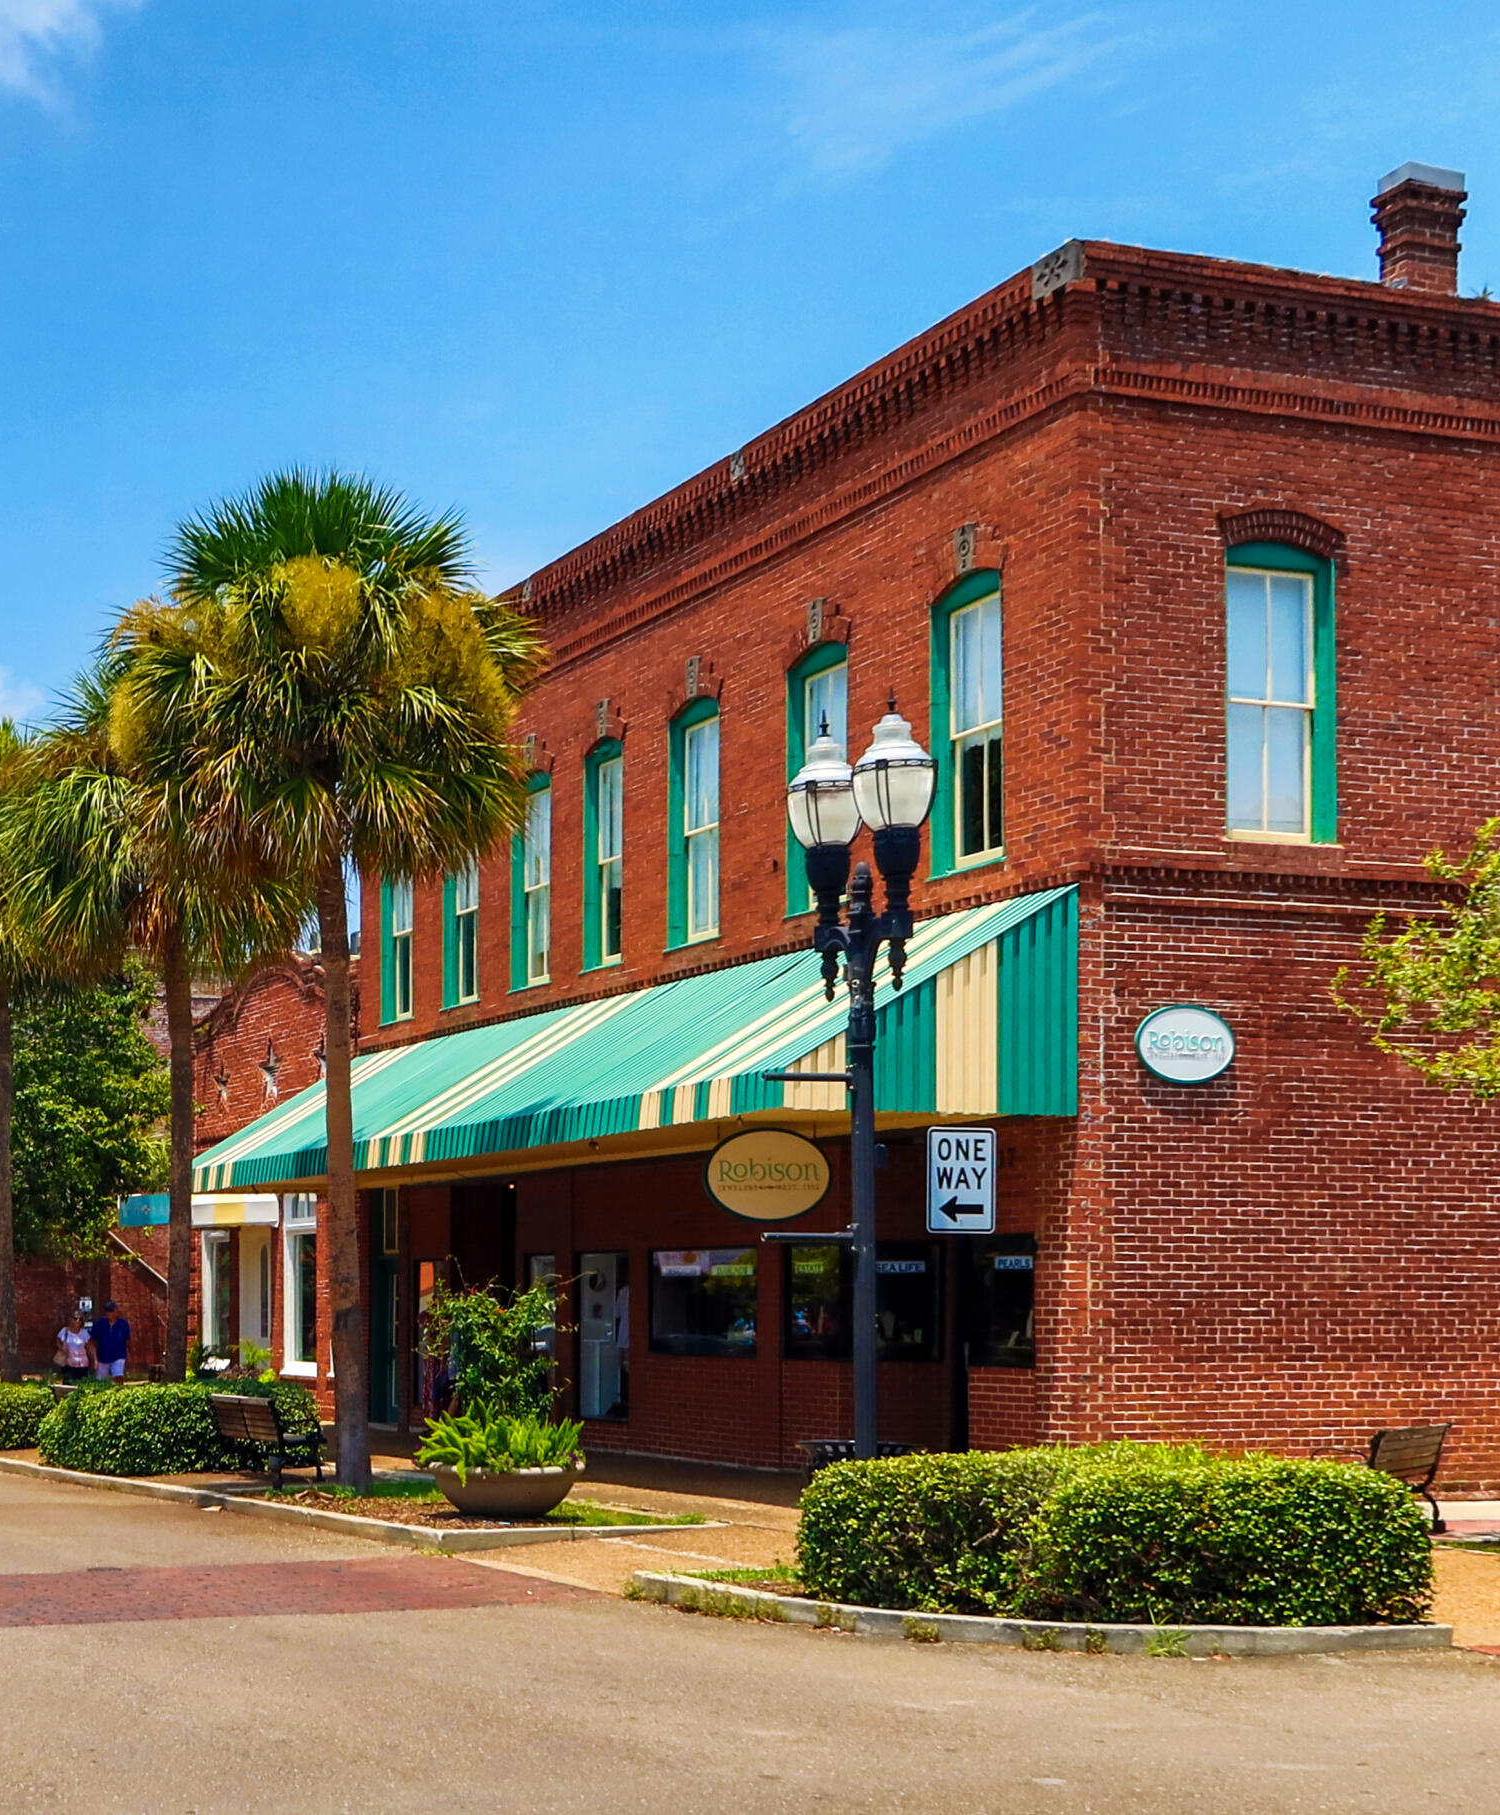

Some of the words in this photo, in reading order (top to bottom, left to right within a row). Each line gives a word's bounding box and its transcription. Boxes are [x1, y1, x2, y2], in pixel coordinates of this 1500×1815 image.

[1147, 1029, 1225, 1052] Robison
[937, 1138, 987, 1161] ONE
[718, 1157, 820, 1183] Robison
[936, 1166, 988, 1190] WAY
[898, 1262, 922, 1273] LIFE
[997, 1258, 1031, 1270] PEARLS
